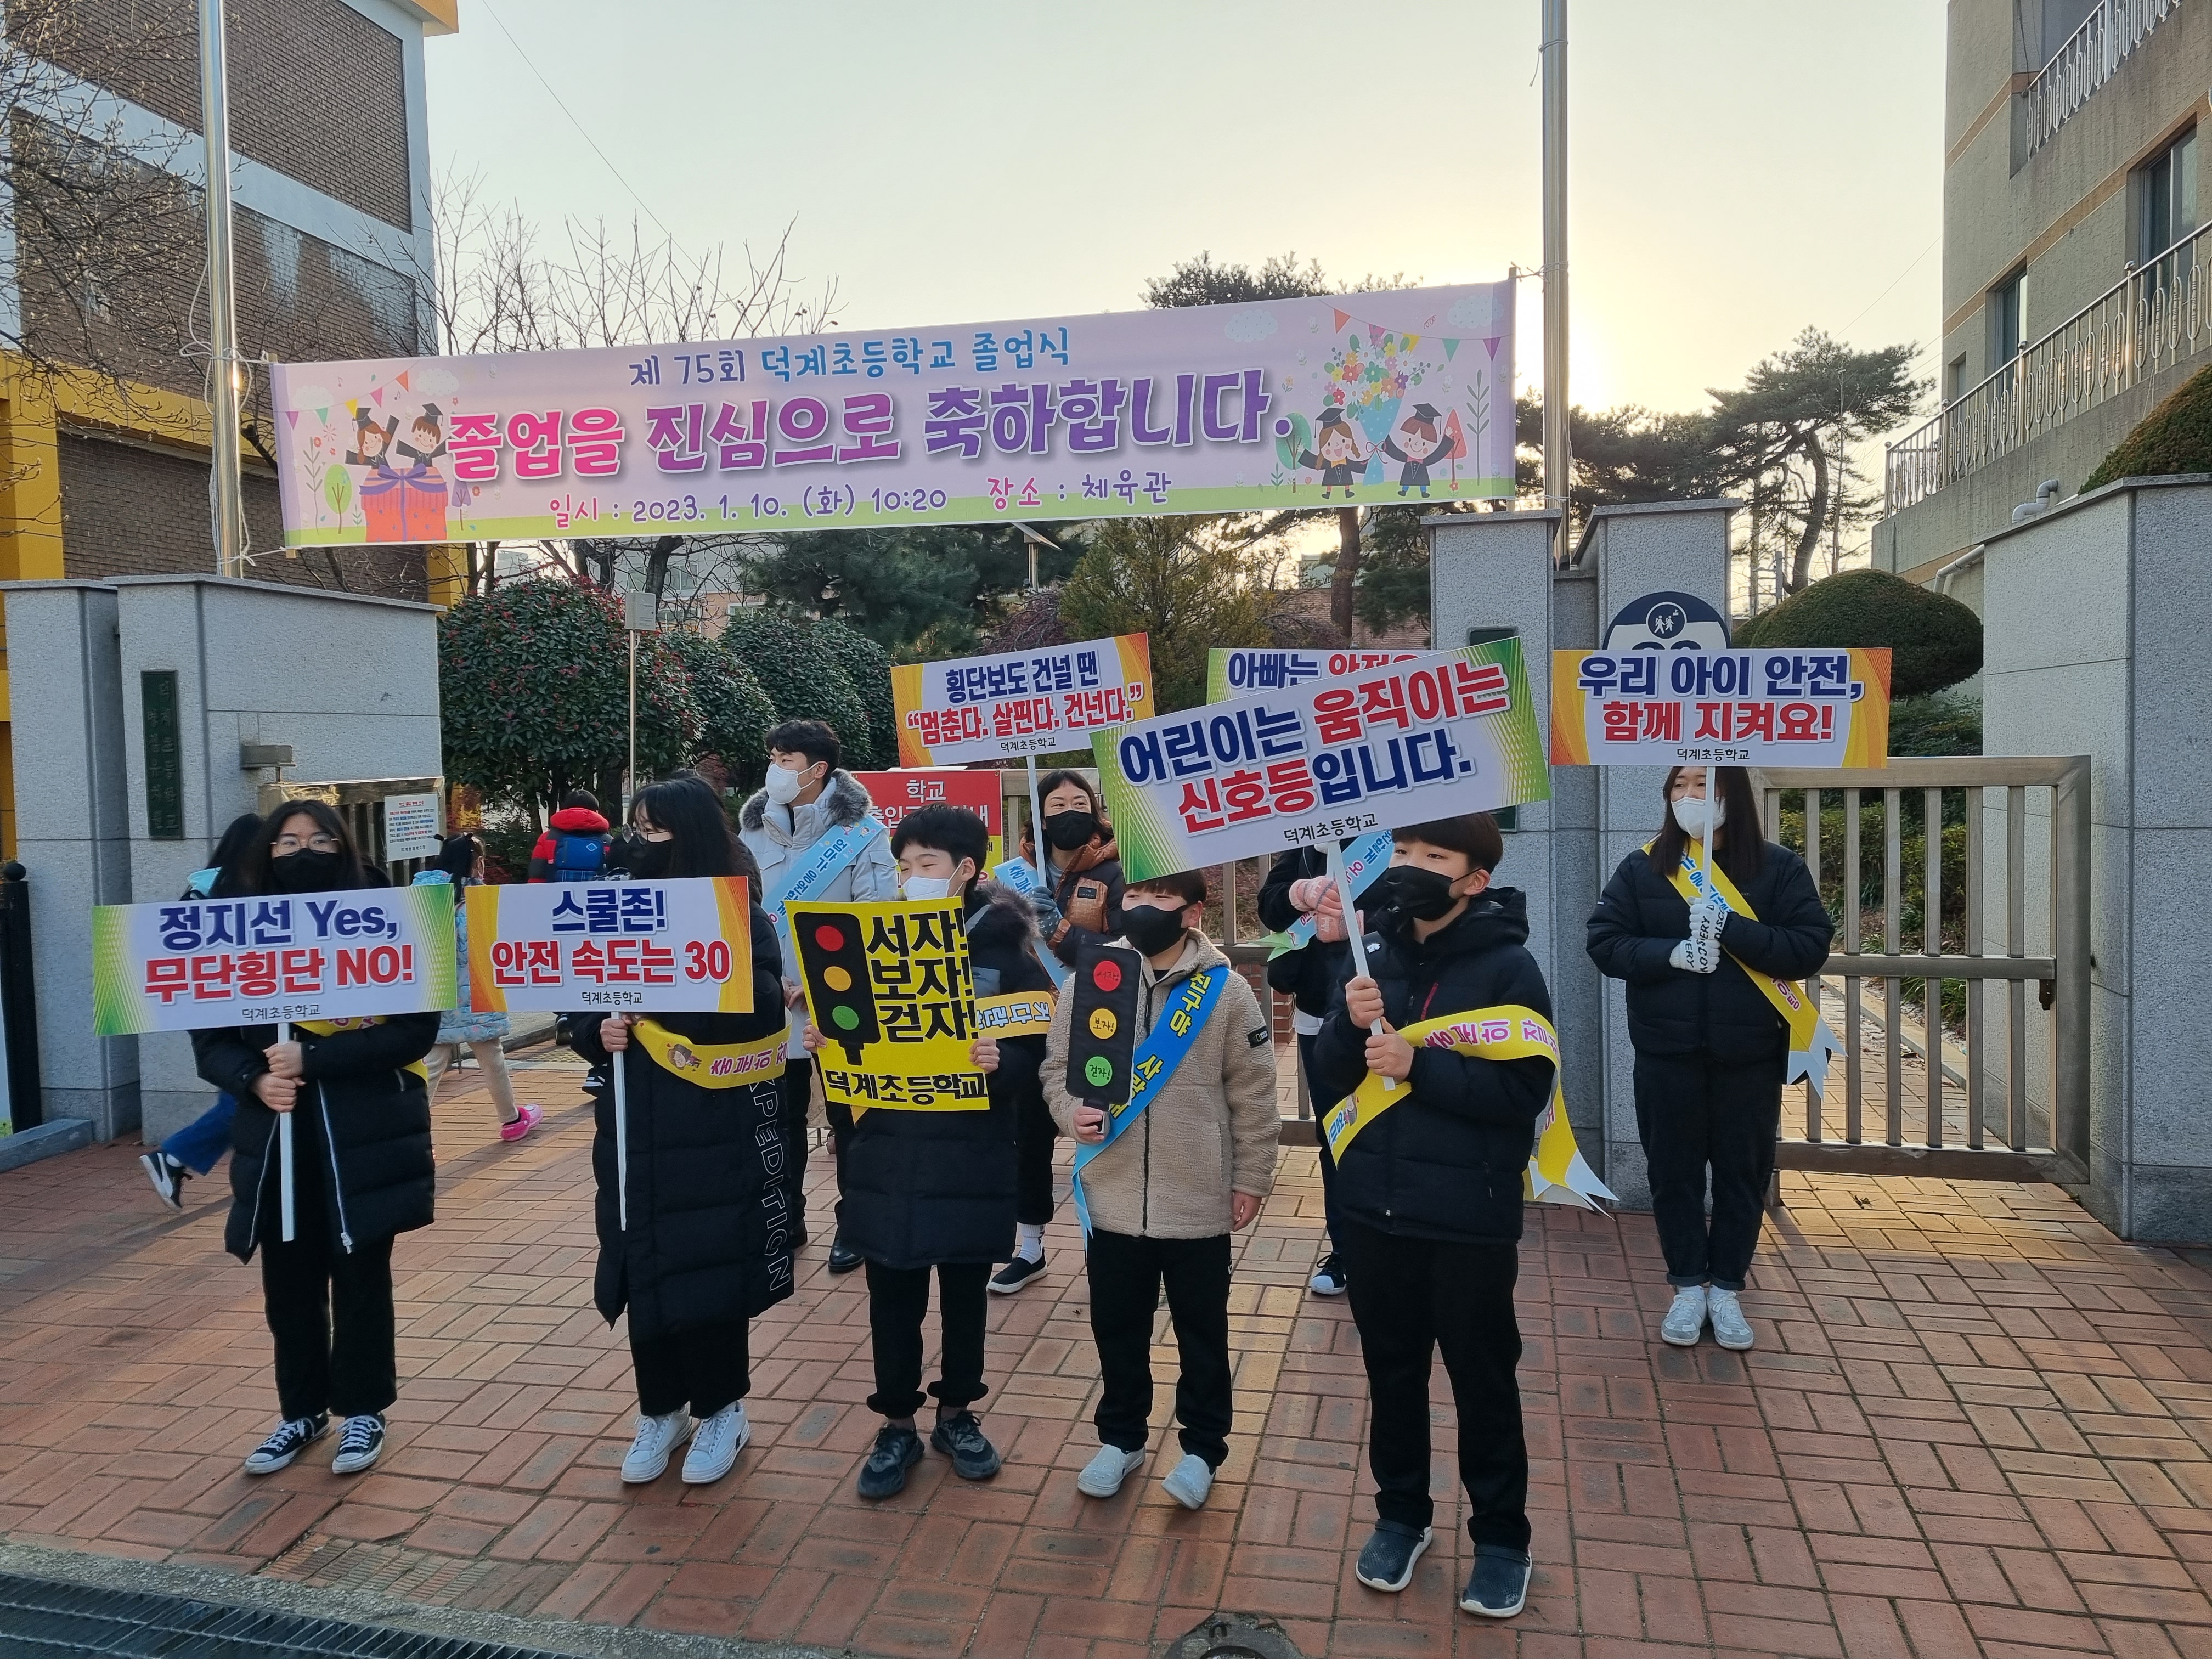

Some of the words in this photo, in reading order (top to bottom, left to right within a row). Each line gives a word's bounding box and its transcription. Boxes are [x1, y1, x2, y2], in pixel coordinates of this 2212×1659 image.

[628, 353, 660, 386] 제
[675, 349, 746, 385] 75회
[762, 336, 956, 383] 덕계초등학교
[972, 327, 1070, 372] 졸업식
[448, 408, 624, 482] 졸업을
[647, 392, 901, 472] 진심으로
[924, 368, 1292, 458] 축하합니다.
[549, 493, 598, 528] 일시
[633, 496, 705, 521] 2023.
[719, 495, 737, 519] 1.
[752, 494, 787, 518] 10.
[803, 484, 855, 517] (화)
[871, 488, 946, 512] 10:20
[988, 476, 1041, 511] 장소
[1082, 470, 1172, 504] 체육관
[946, 662, 1028, 703] 횡단보도
[1031, 654, 1071, 692] 건널
[1076, 651, 1098, 686] 땐
[1228, 653, 1318, 689] 아빠는
[1579, 656, 1655, 696] 우리
[1671, 656, 1750, 696] 아이
[1764, 653, 1862, 699] 안전,
[994, 697, 1060, 737] 살핀다.
[1120, 706, 1306, 785] 어린이는
[1313, 663, 1508, 744] 움직이는
[1602, 701, 1680, 741] 함께
[1694, 702, 1833, 742] 지켜요!
[1000, 736, 1056, 753] 덕계초등학교
[1677, 749, 1750, 761] 덕계초등학교
[906, 780, 946, 803] 학교
[1179, 729, 1472, 833] 신호등입니다.
[1284, 814, 1378, 844] 덕계초등학교
[160, 900, 292, 950] 정지선
[306, 900, 398, 940] Yes,
[552, 888, 665, 933] 스쿨존!
[867, 909, 969, 957] 서자!
[144, 949, 325, 1003] 무단횡단
[336, 944, 413, 986] NO!
[492, 941, 561, 984] 안전
[572, 940, 674, 983] 속도는
[685, 941, 730, 980] 30
[870, 956, 973, 1000] 보자!
[241, 1005, 321, 1022] 덕계초등학교
[582, 991, 643, 1005] 덕계초등학교
[1170, 972, 1211, 1037] 친구야
[879, 1000, 979, 1042] 걷자!
[825, 1070, 987, 1105] 덕계초등학교
